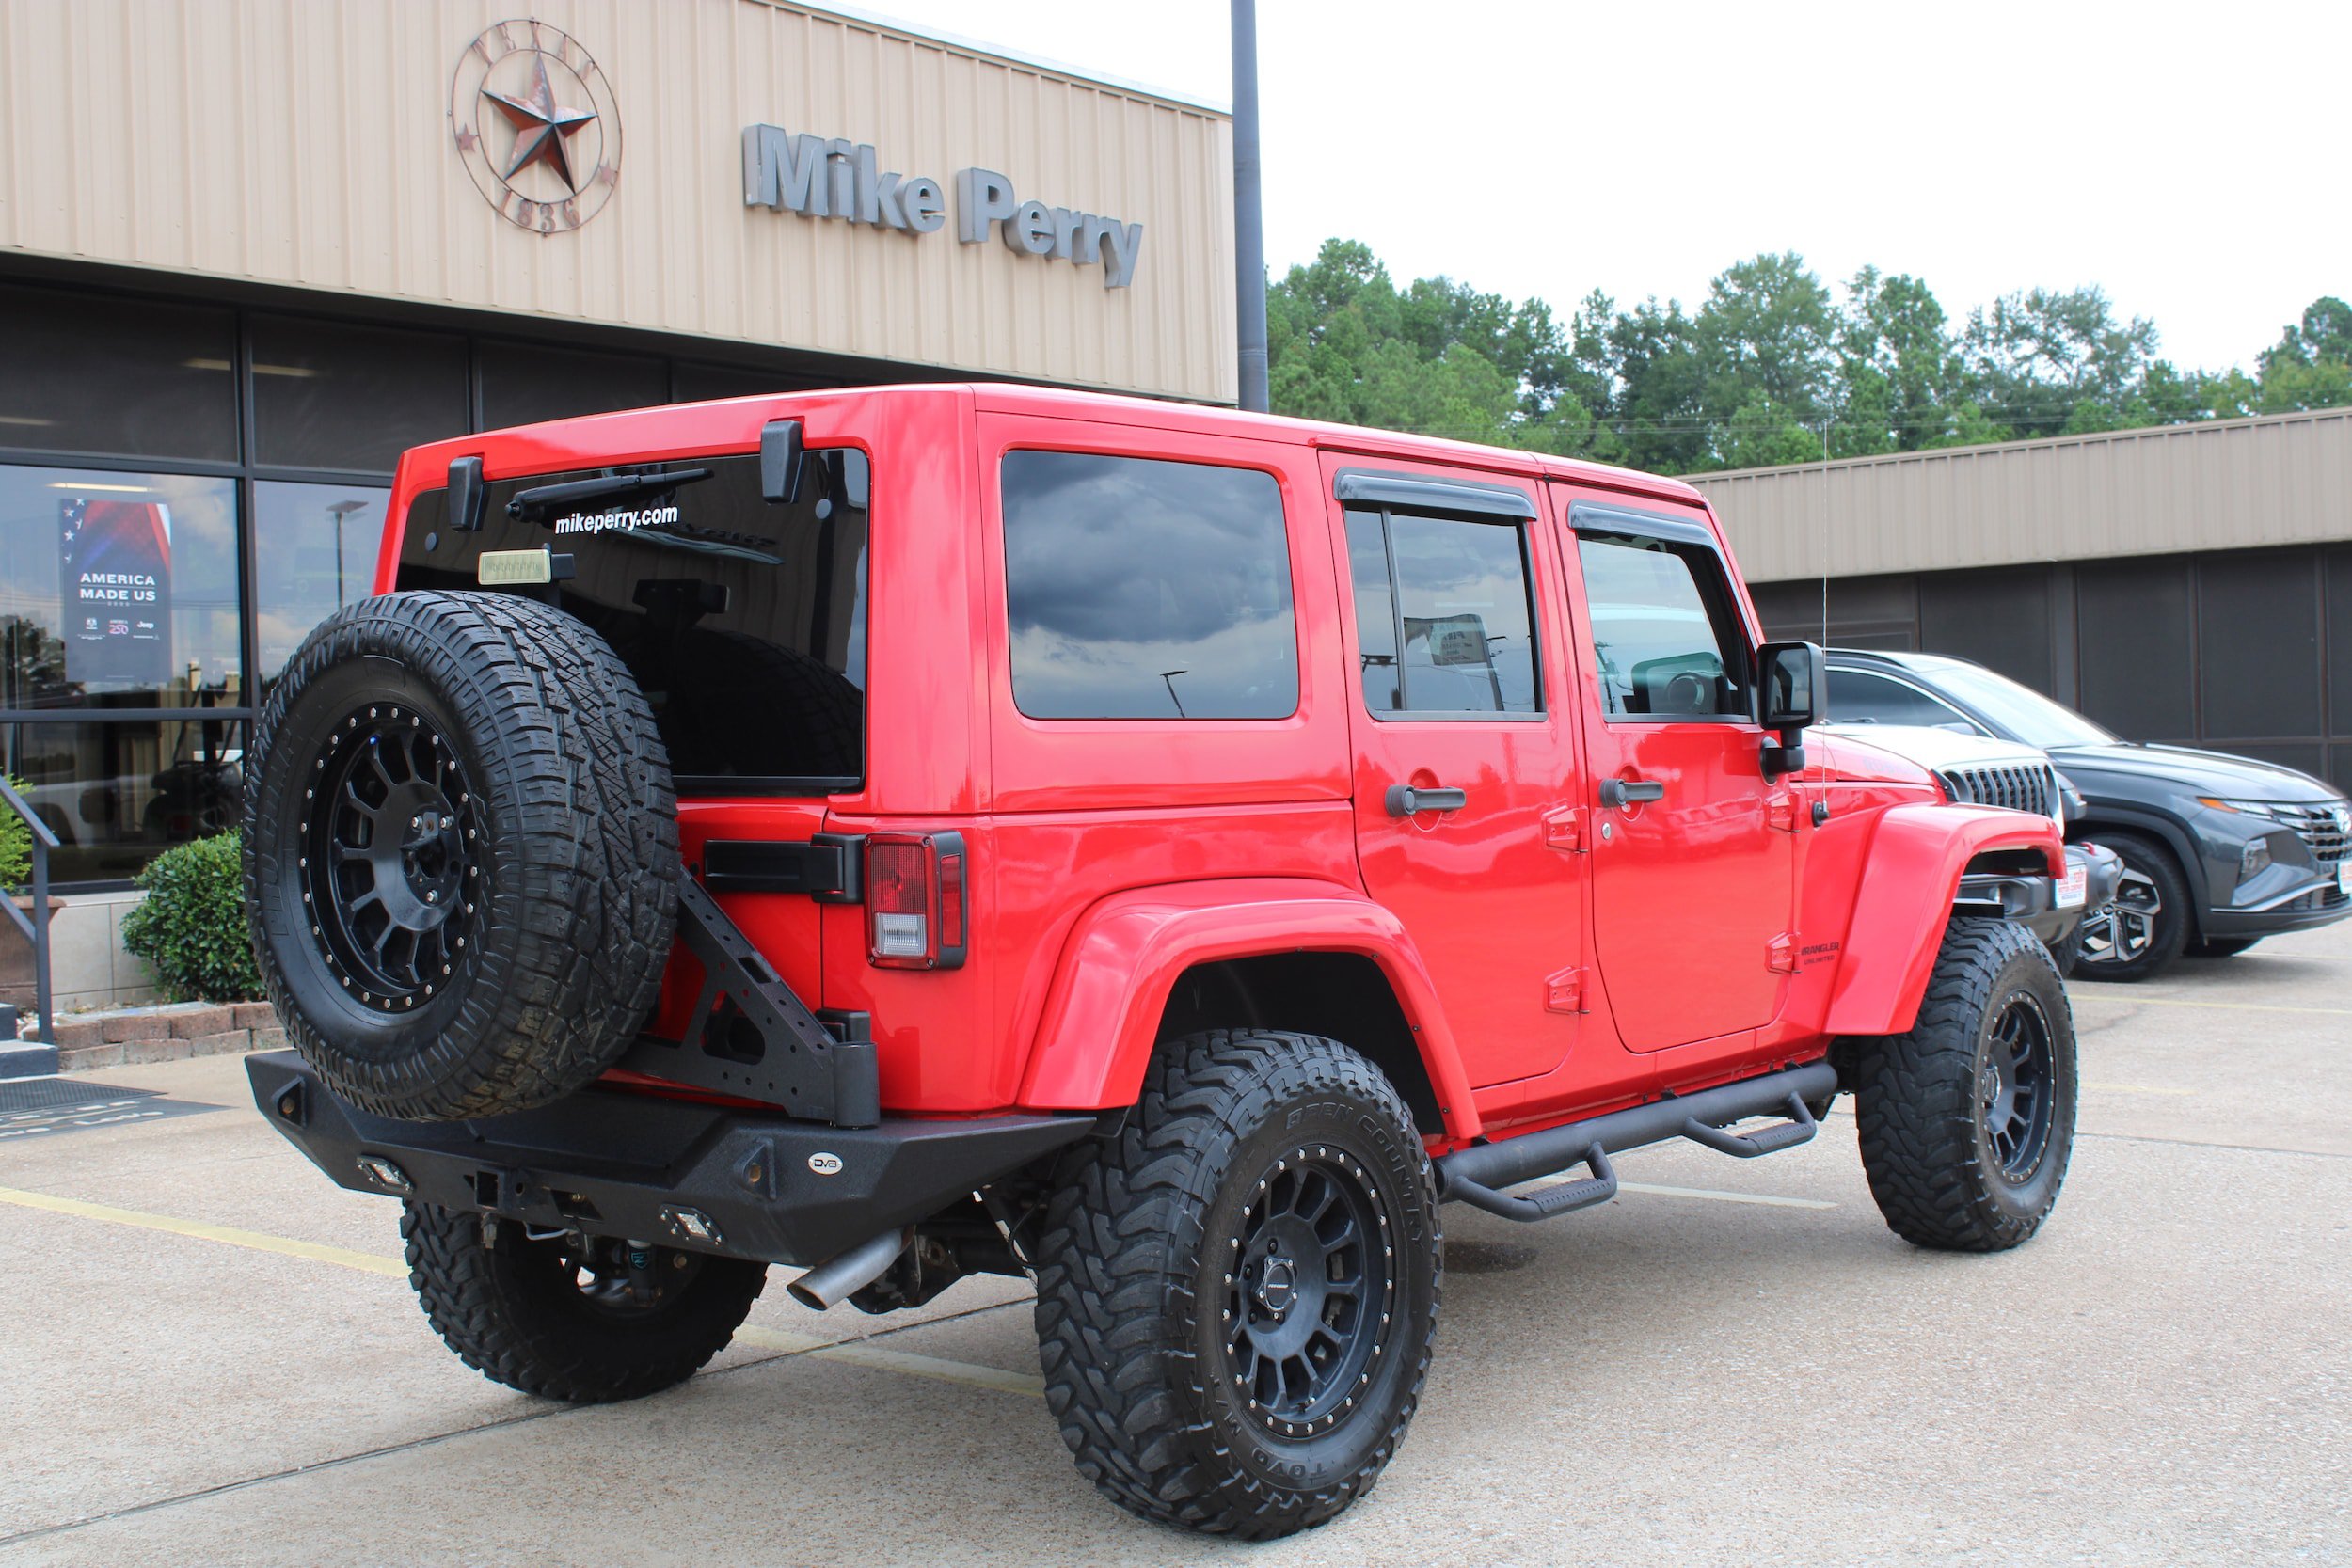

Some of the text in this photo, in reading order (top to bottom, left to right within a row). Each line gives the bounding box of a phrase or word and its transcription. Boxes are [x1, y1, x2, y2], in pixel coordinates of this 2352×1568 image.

[500, 187, 580, 232] 1836
[742, 123, 1143, 289] Mike Perry
[554, 506, 678, 534] mikeperry.com
[80, 573, 155, 585] AMERICA
[80, 588, 156, 601] MADE US
[137, 621, 154, 629] Jeep
[1802, 942, 1839, 955] WRANGLER
[1286, 1102, 1353, 1130] OPEN
[1357, 1114, 1424, 1249] COUNTRY
[1251, 1447, 1327, 1484] TOYO
